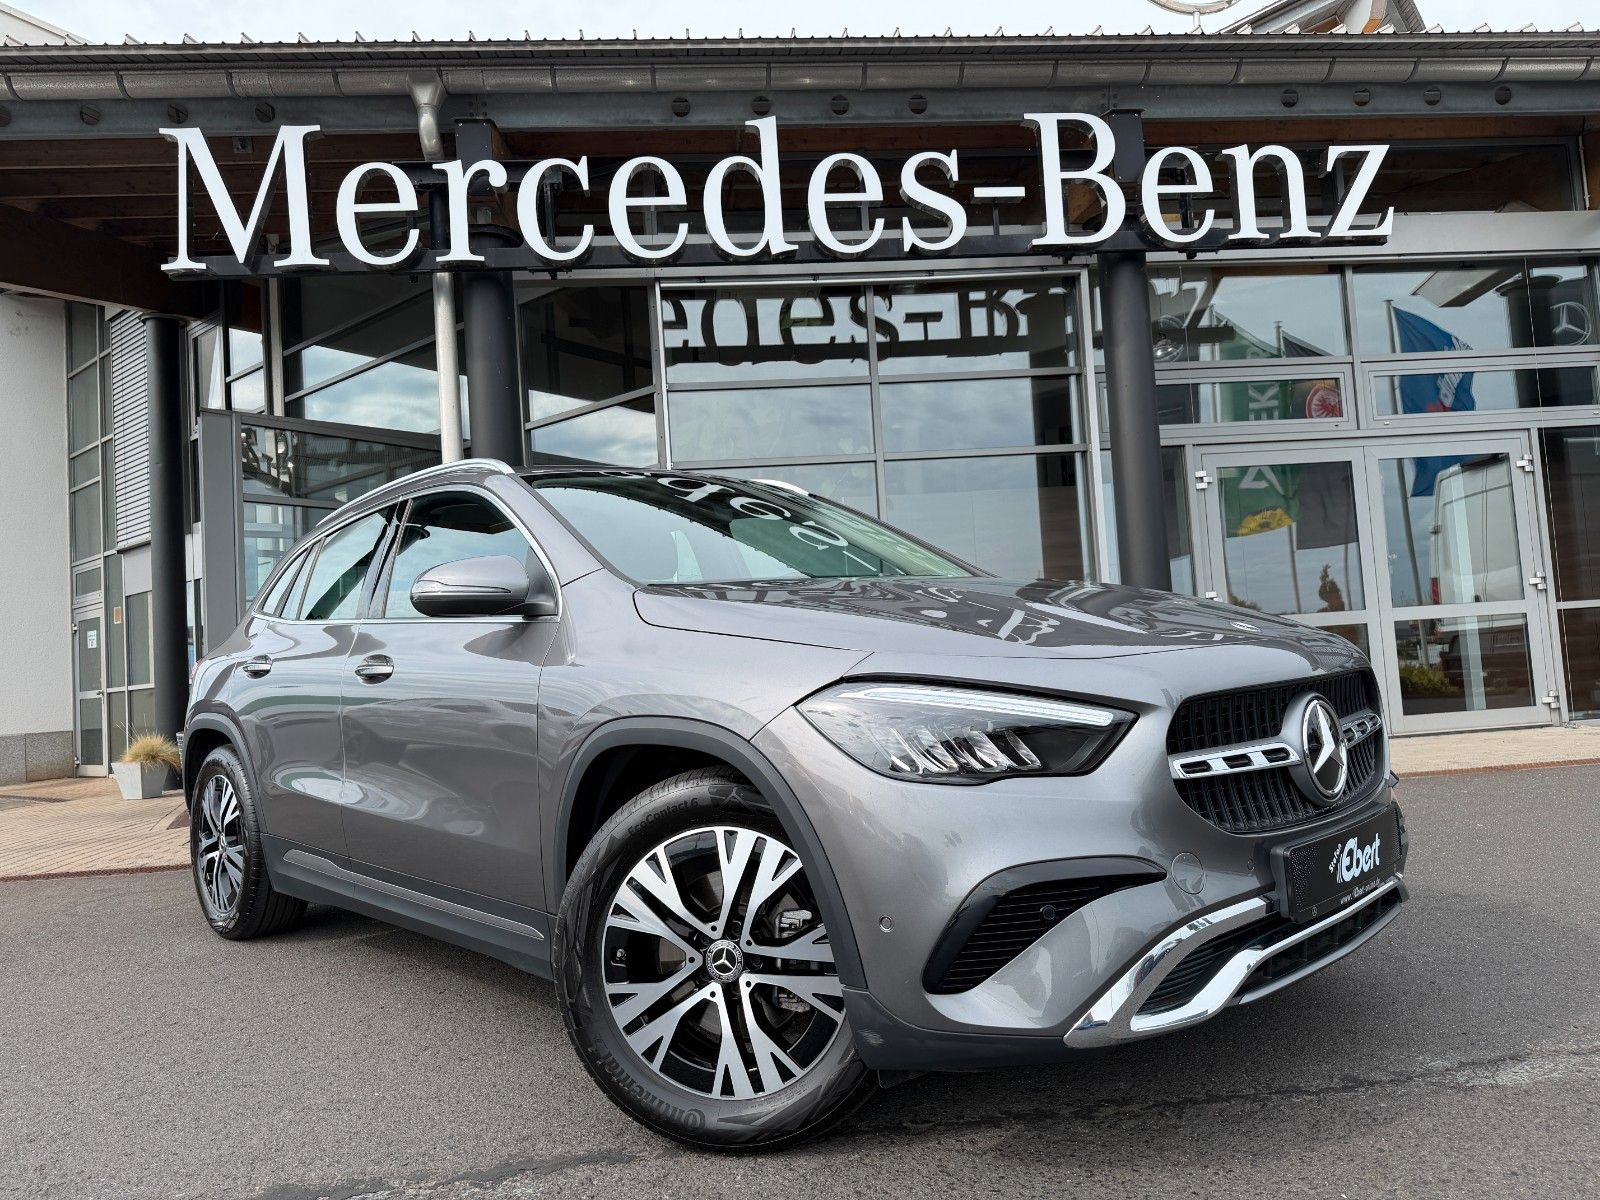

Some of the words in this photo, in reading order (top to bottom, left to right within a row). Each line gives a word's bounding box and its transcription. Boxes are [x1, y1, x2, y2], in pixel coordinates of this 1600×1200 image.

[159, 112, 1395, 273] Mercedes-Benz
[627, 799, 691, 837] EcoContact
[690, 797, 700, 808] 6
[1340, 832, 1381, 882] Ebert
[596, 1051, 706, 1134] Continental
